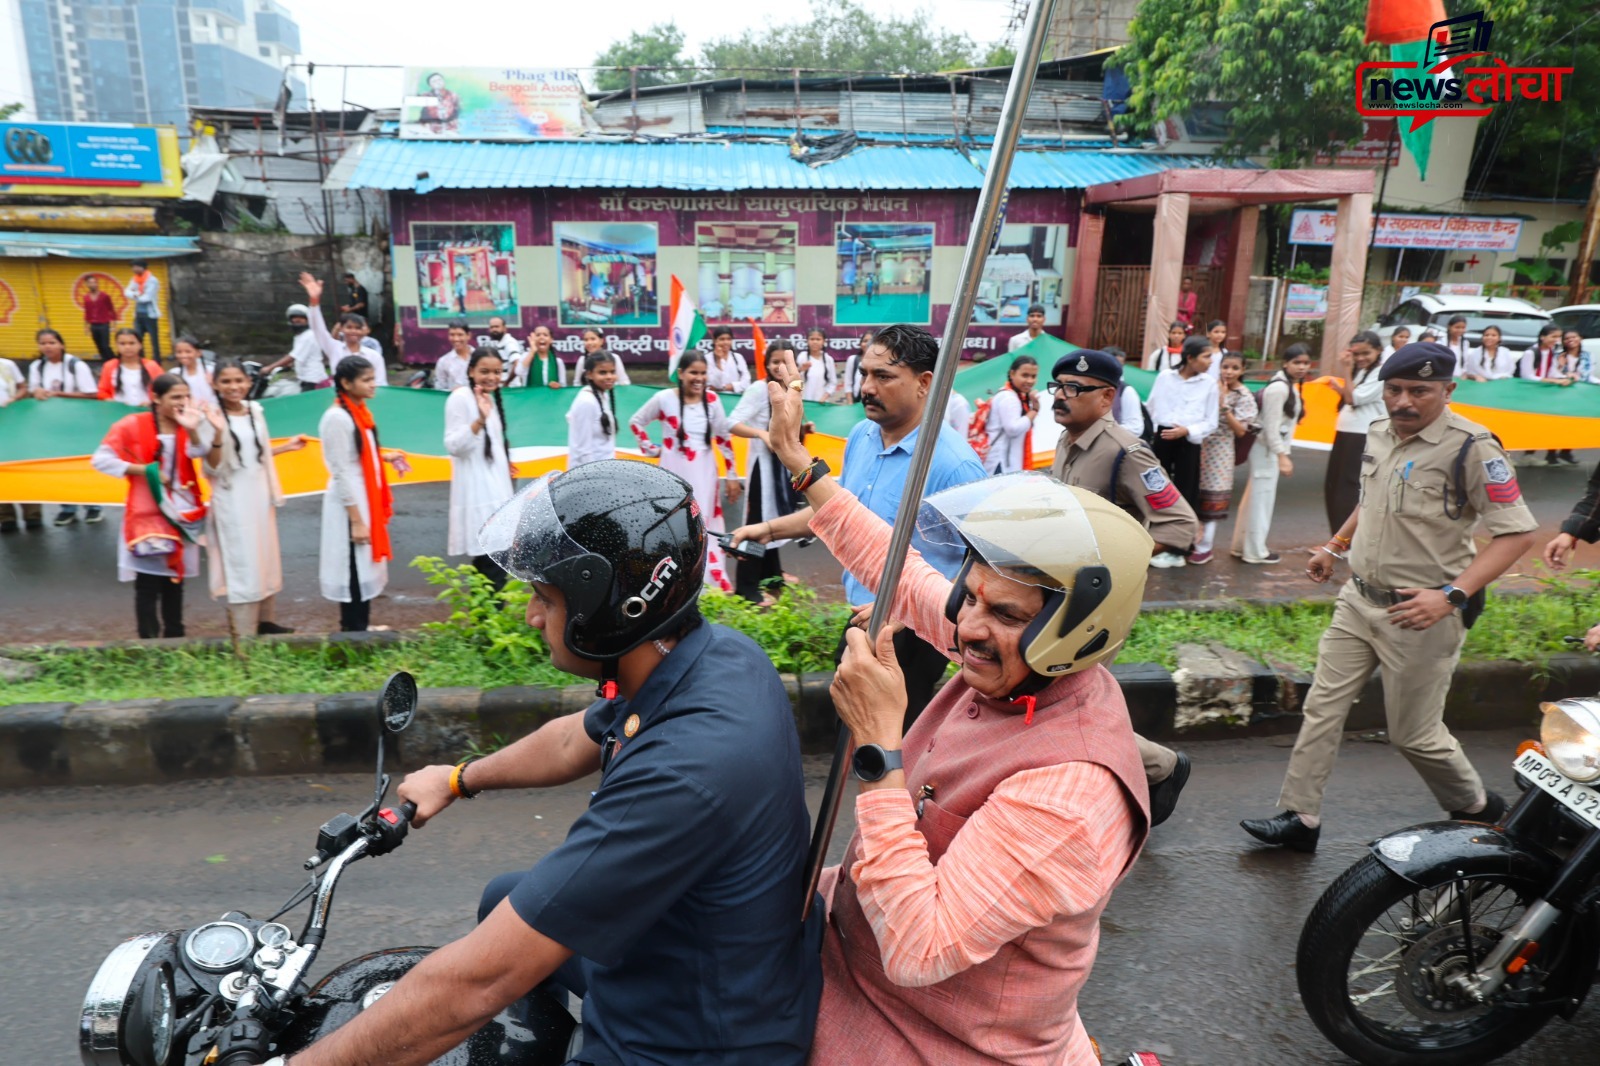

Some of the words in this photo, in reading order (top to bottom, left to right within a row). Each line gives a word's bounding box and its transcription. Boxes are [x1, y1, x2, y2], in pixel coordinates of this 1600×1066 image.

[489, 82, 538, 93] Bengali
[744, 191, 859, 218] सामुदायिक
[861, 196, 909, 212] भवन
[640, 557, 678, 601] CITI
